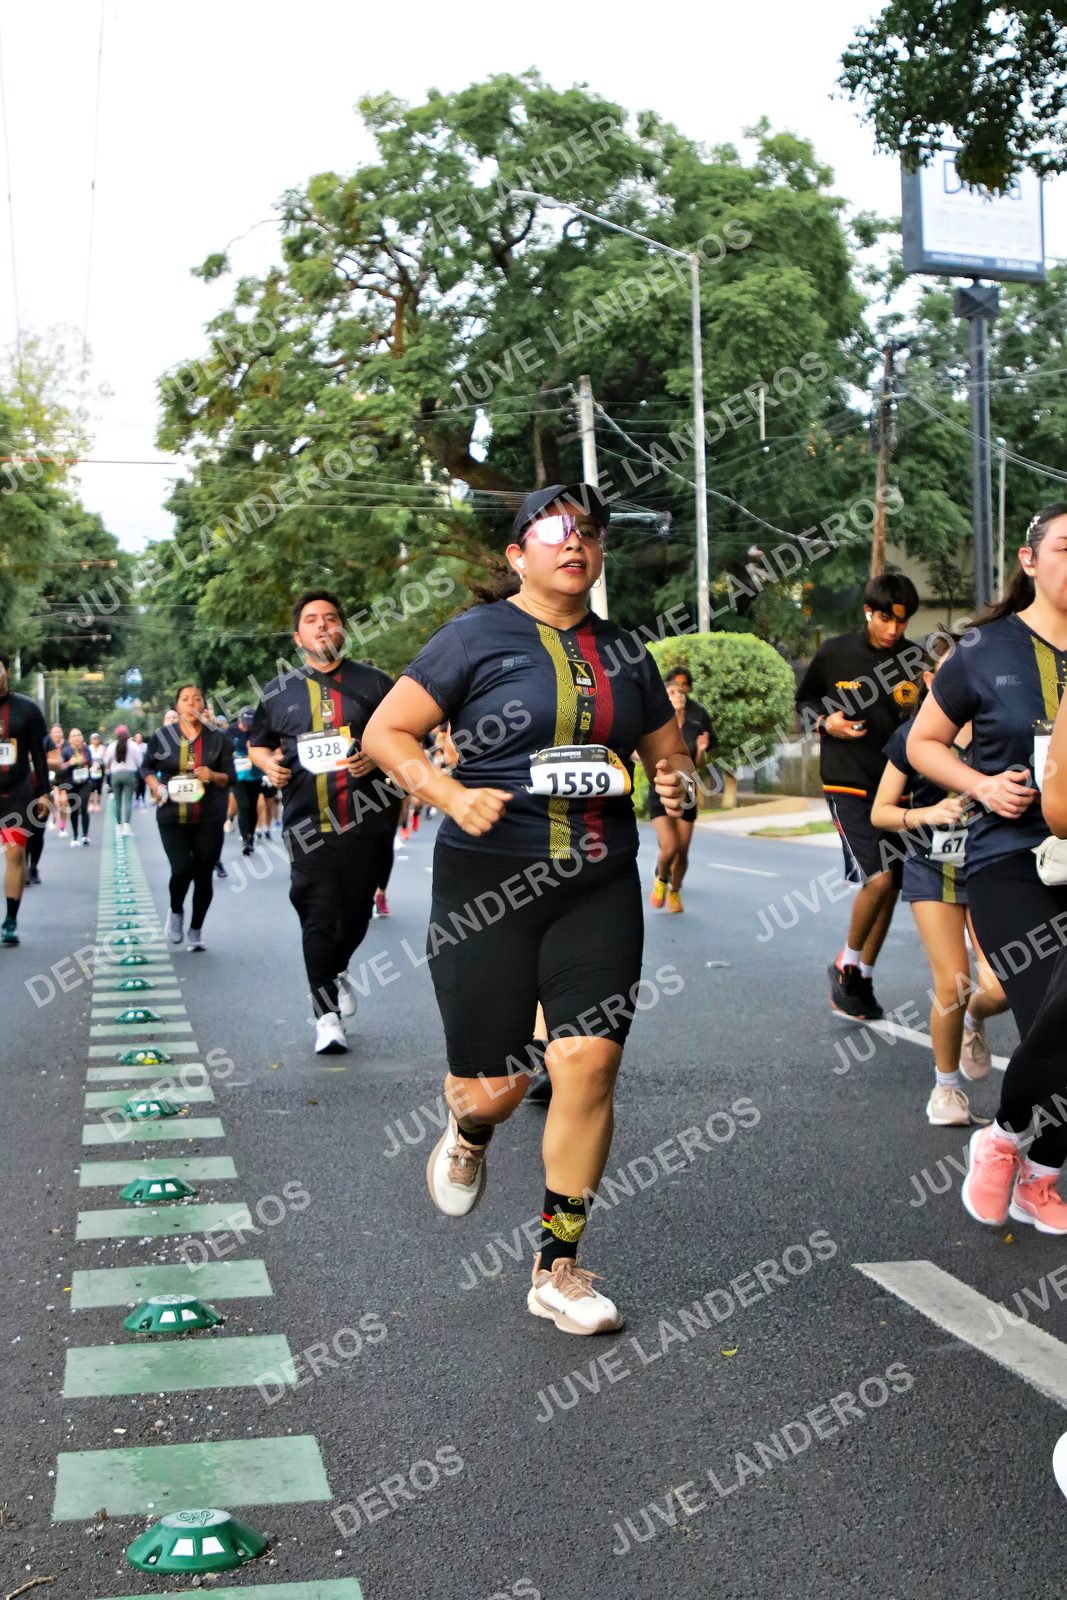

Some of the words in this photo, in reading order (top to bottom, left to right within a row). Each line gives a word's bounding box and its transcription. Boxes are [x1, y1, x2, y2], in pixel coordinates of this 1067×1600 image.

[307, 742, 341, 759] 3328
[177, 783, 194, 793] 282
[546, 771, 611, 795] 1559
[941, 837, 964, 854] 67
